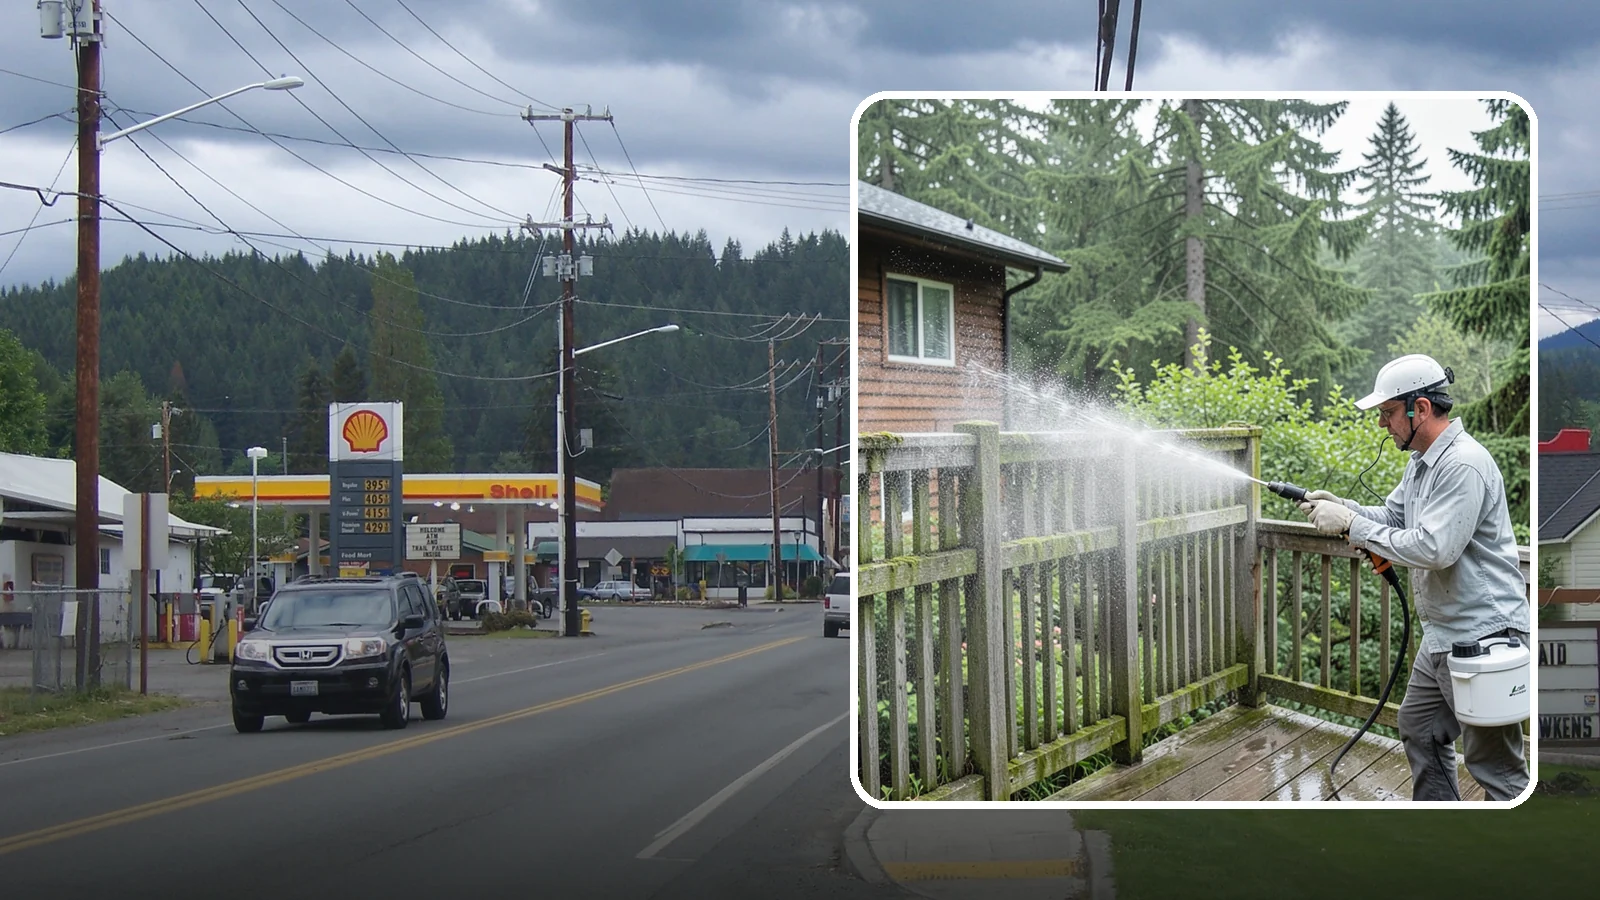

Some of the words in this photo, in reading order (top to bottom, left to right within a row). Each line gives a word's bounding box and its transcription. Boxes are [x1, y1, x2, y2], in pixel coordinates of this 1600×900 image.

[366, 480, 383, 490] 395
[490, 484, 547, 499] Shell
[366, 494, 383, 504] 405
[366, 508, 383, 518] 415
[366, 522, 383, 532] 429
